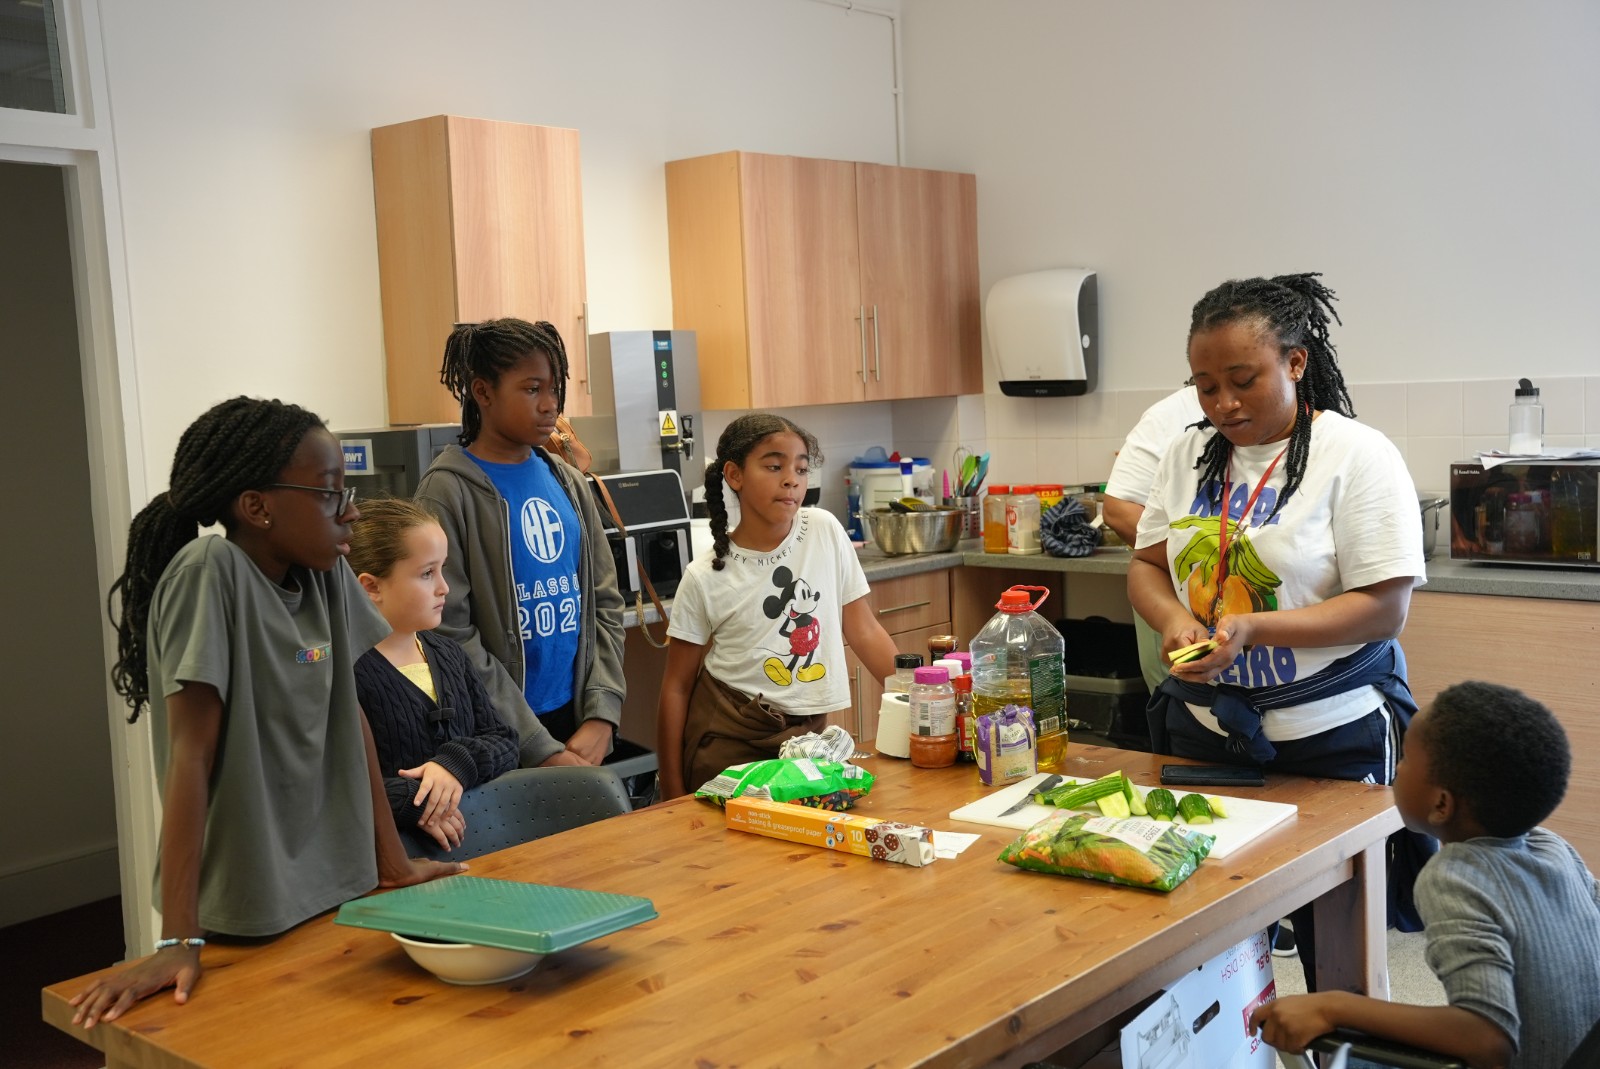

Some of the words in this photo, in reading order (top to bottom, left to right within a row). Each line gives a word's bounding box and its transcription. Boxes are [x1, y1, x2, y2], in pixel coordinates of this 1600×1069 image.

[758, 546, 792, 566] MICKEY
[516, 575, 570, 602] LASS
[748, 818, 767, 828] baking
[772, 822, 805, 834] greaseproof
[805, 829, 823, 838] paper
[851, 830, 863, 843] 10
[1145, 827, 1161, 842] TESCO
[1221, 956, 1240, 984] DISH
